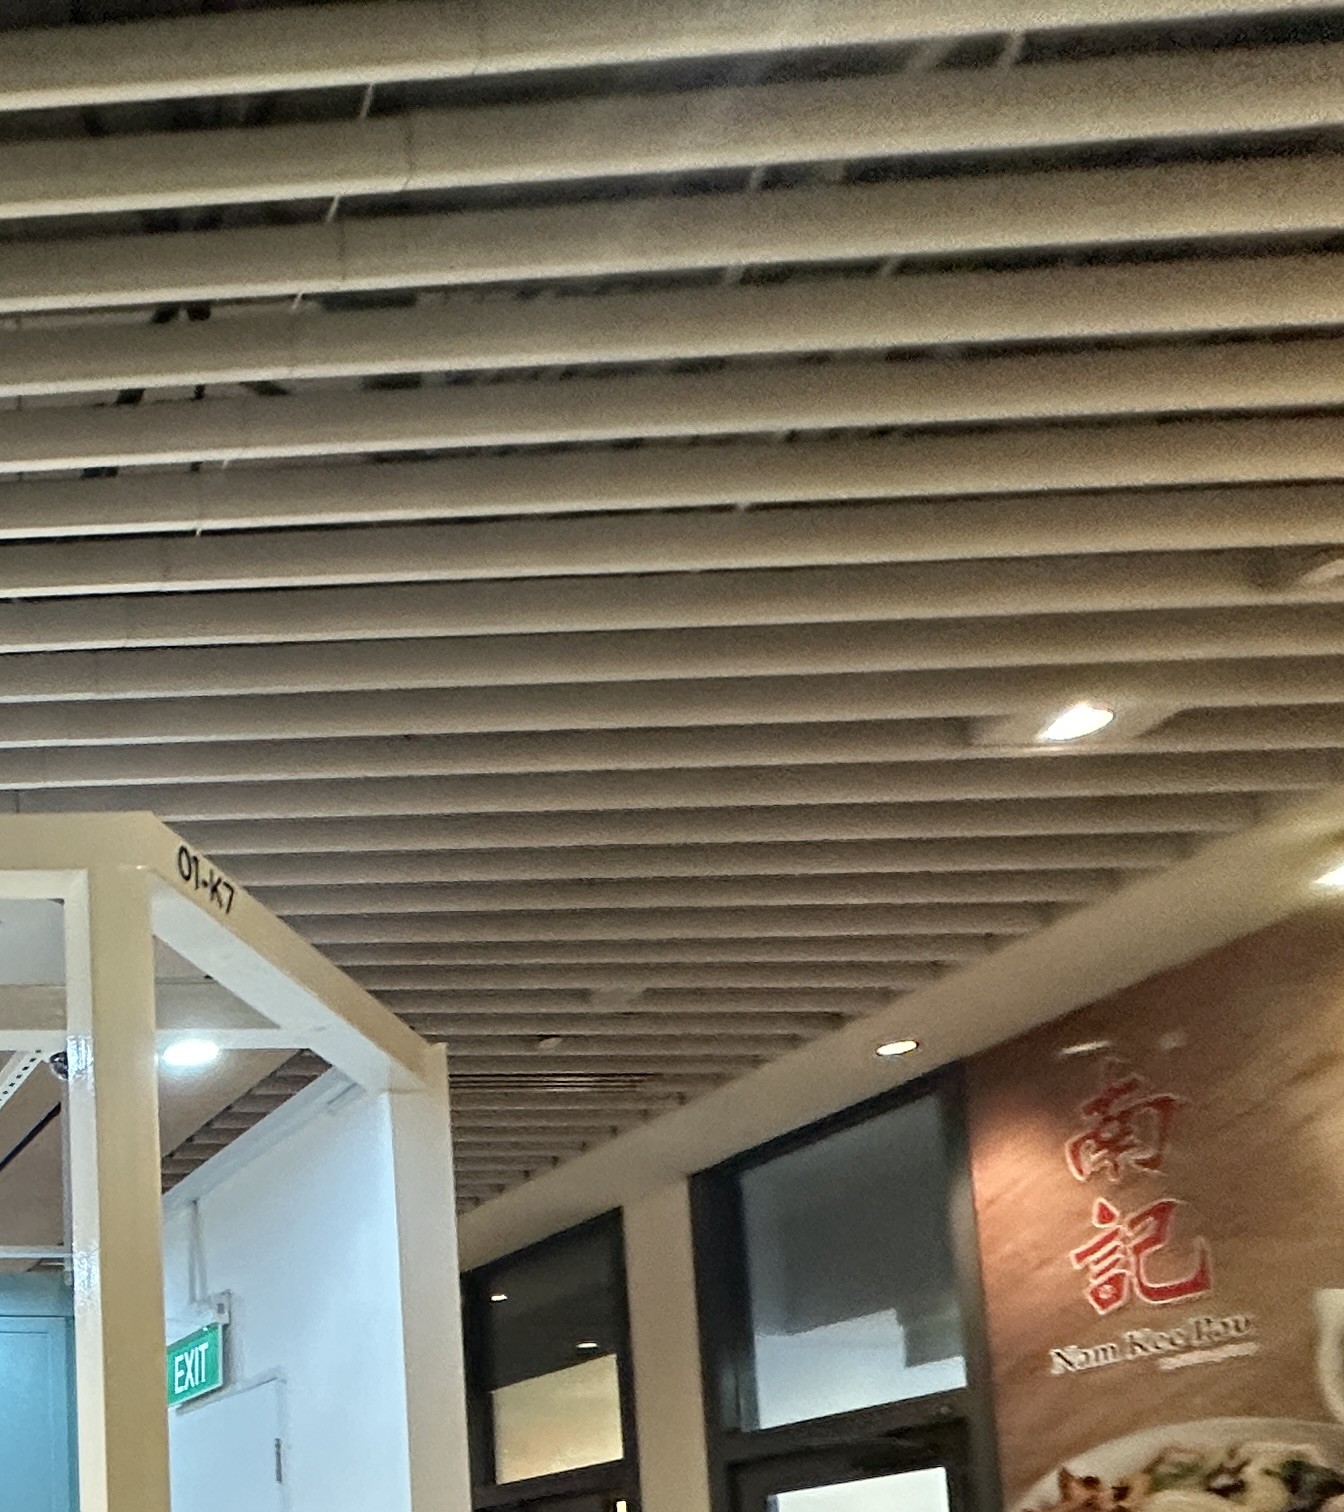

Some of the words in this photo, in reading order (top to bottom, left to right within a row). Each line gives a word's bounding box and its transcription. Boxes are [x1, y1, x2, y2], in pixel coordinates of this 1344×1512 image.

[177, 845, 234, 914] 01-K7
[174, 1341, 210, 1395] EXIT
[1049, 1342, 1119, 1375] Nam
[1122, 1328, 1186, 1360] Kee
